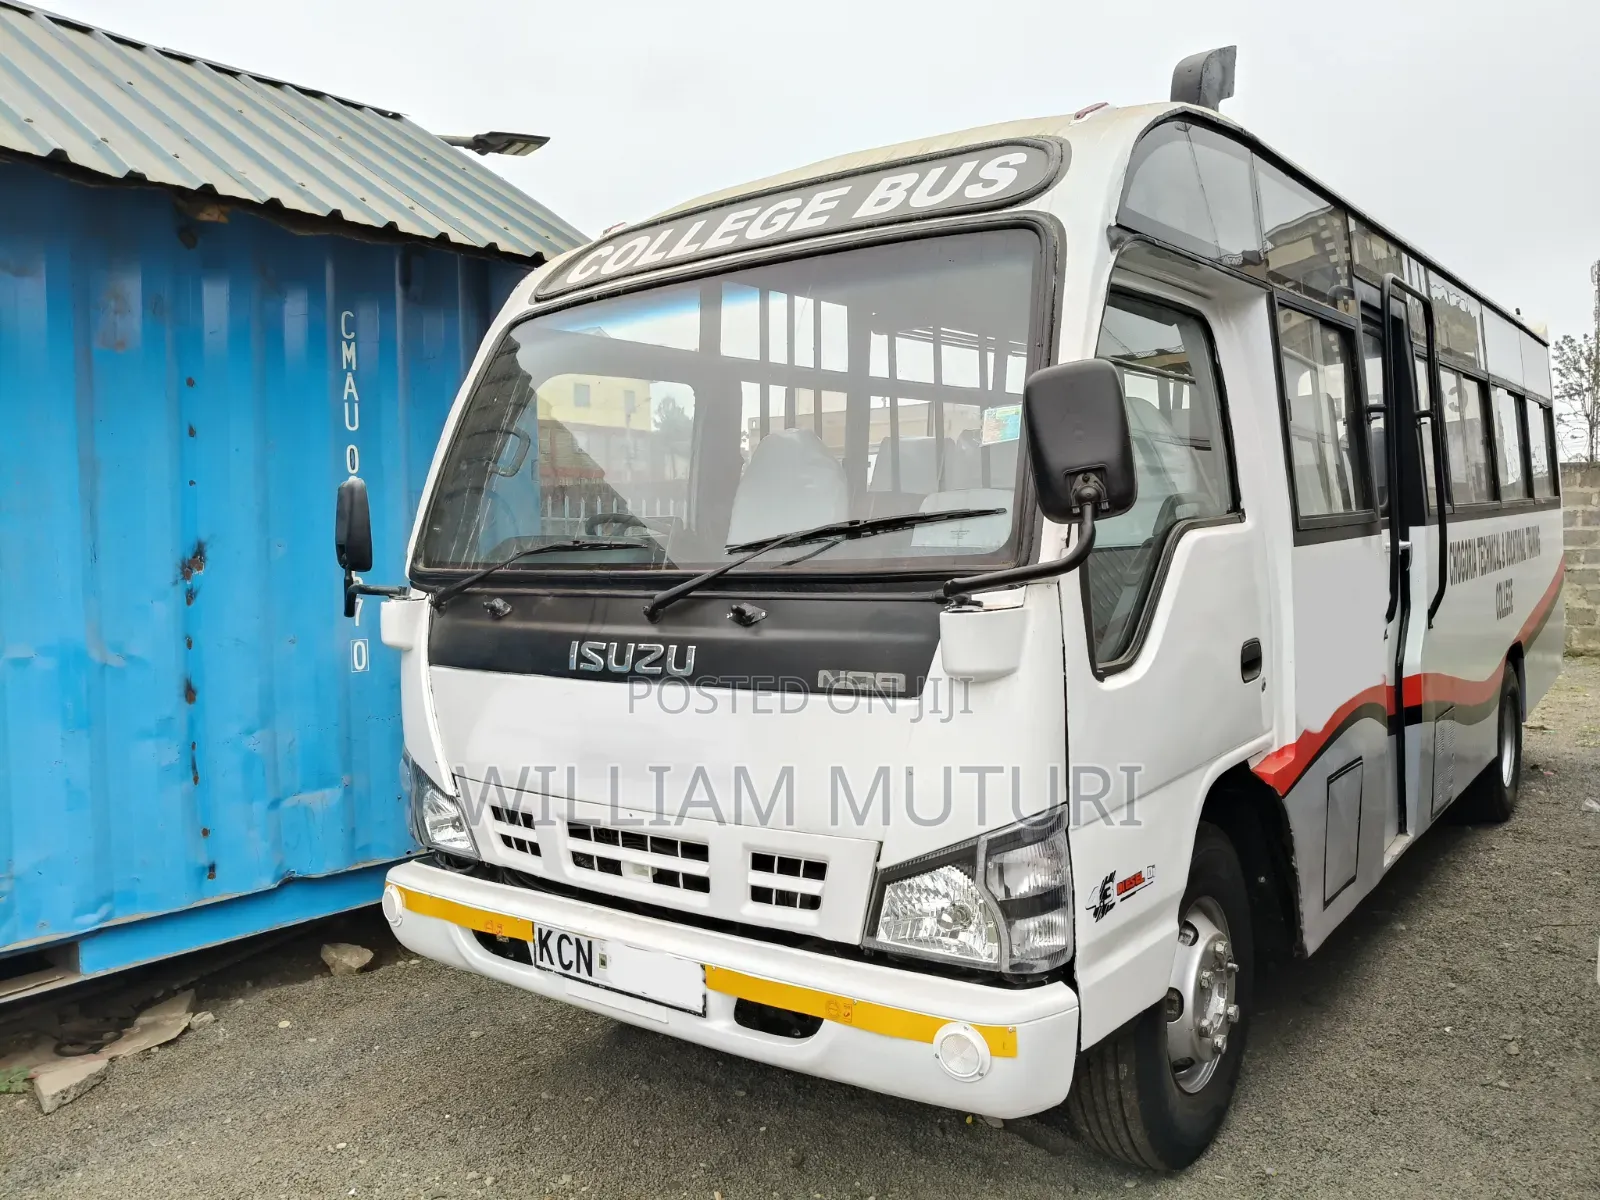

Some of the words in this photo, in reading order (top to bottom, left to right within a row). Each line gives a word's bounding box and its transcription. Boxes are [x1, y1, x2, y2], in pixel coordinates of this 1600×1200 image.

[565, 185, 852, 286] COLLEGE
[852, 153, 1028, 217] BUS
[341, 310, 360, 432] CMAU
[568, 640, 697, 677] ISUZU
[1116, 870, 1145, 896] DIESEL
[538, 927, 593, 977] KCN
